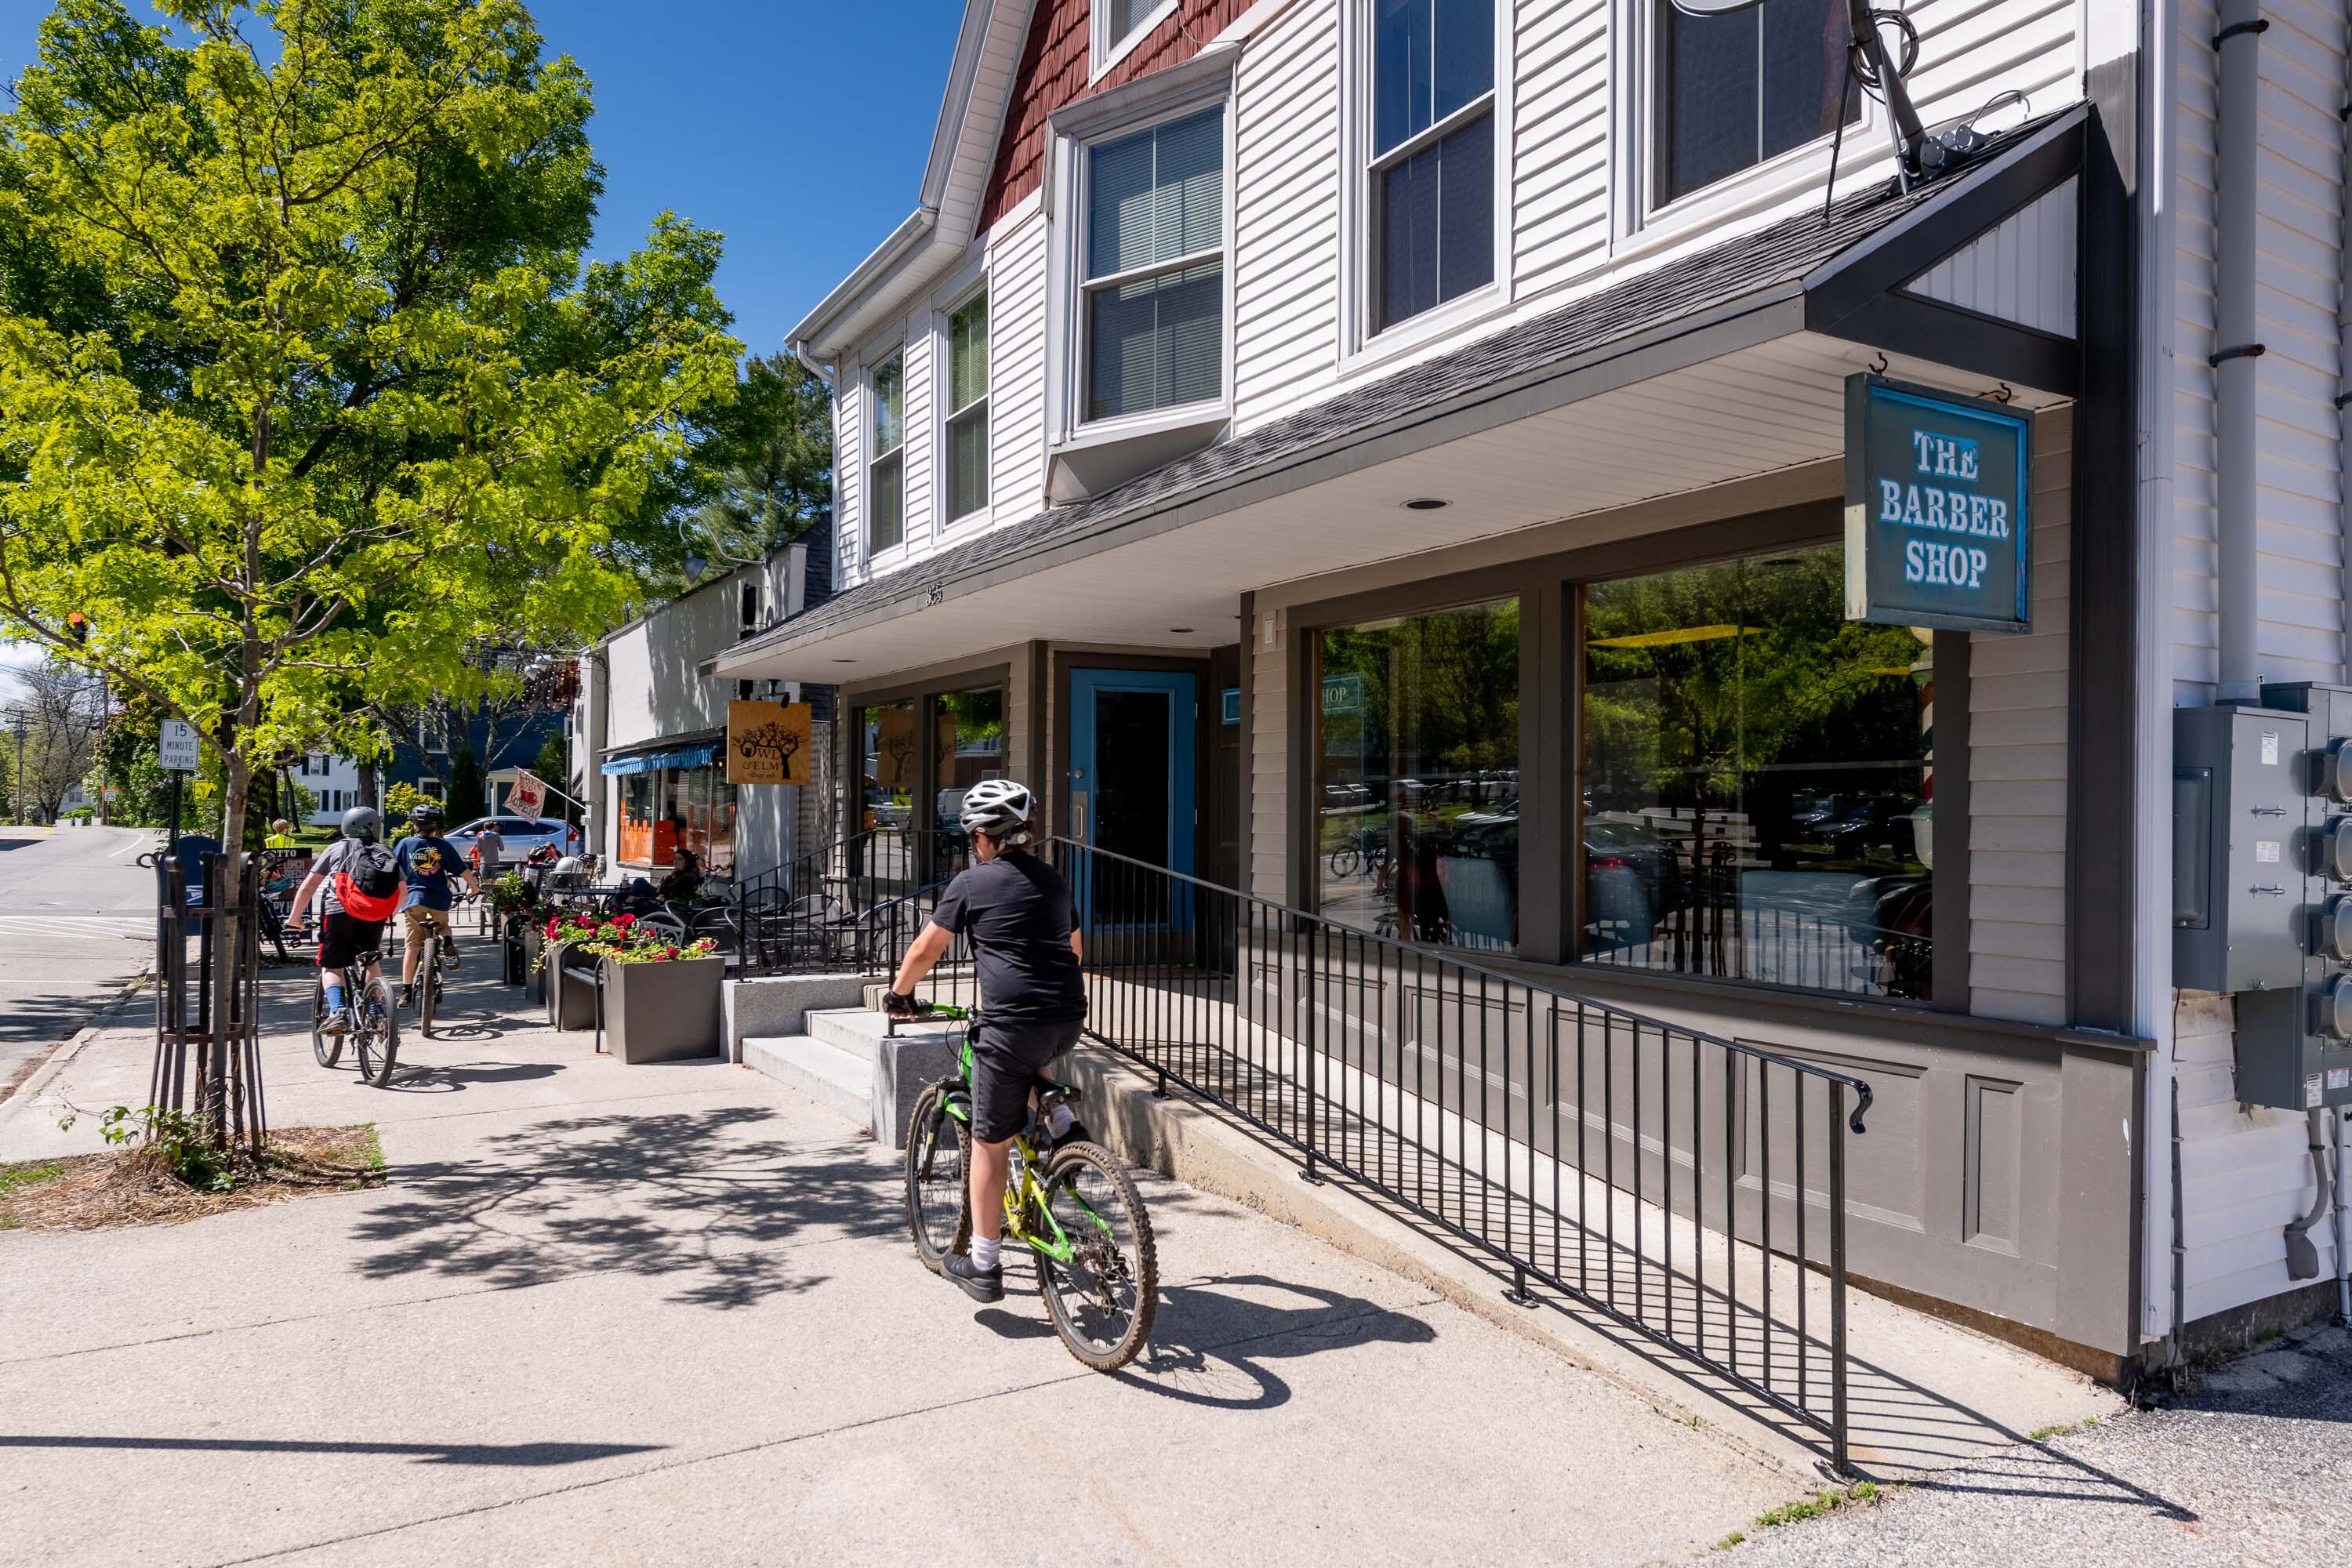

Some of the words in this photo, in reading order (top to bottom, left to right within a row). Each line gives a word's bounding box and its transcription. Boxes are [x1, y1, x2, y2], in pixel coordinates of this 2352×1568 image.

[1914, 431, 1978, 480] THE
[1879, 478, 2009, 539] BARBER
[1906, 540, 1987, 588] SHOP
[1322, 687, 1346, 703] HOP
[175, 725, 187, 737] 15
[166, 741, 194, 751] MINUTE
[164, 754, 194, 765] PARKING
[753, 761, 779, 771] ELM
[512, 797, 538, 818] OPEN
[408, 852, 428, 861] VANS
[283, 859, 305, 869] LUNCH
